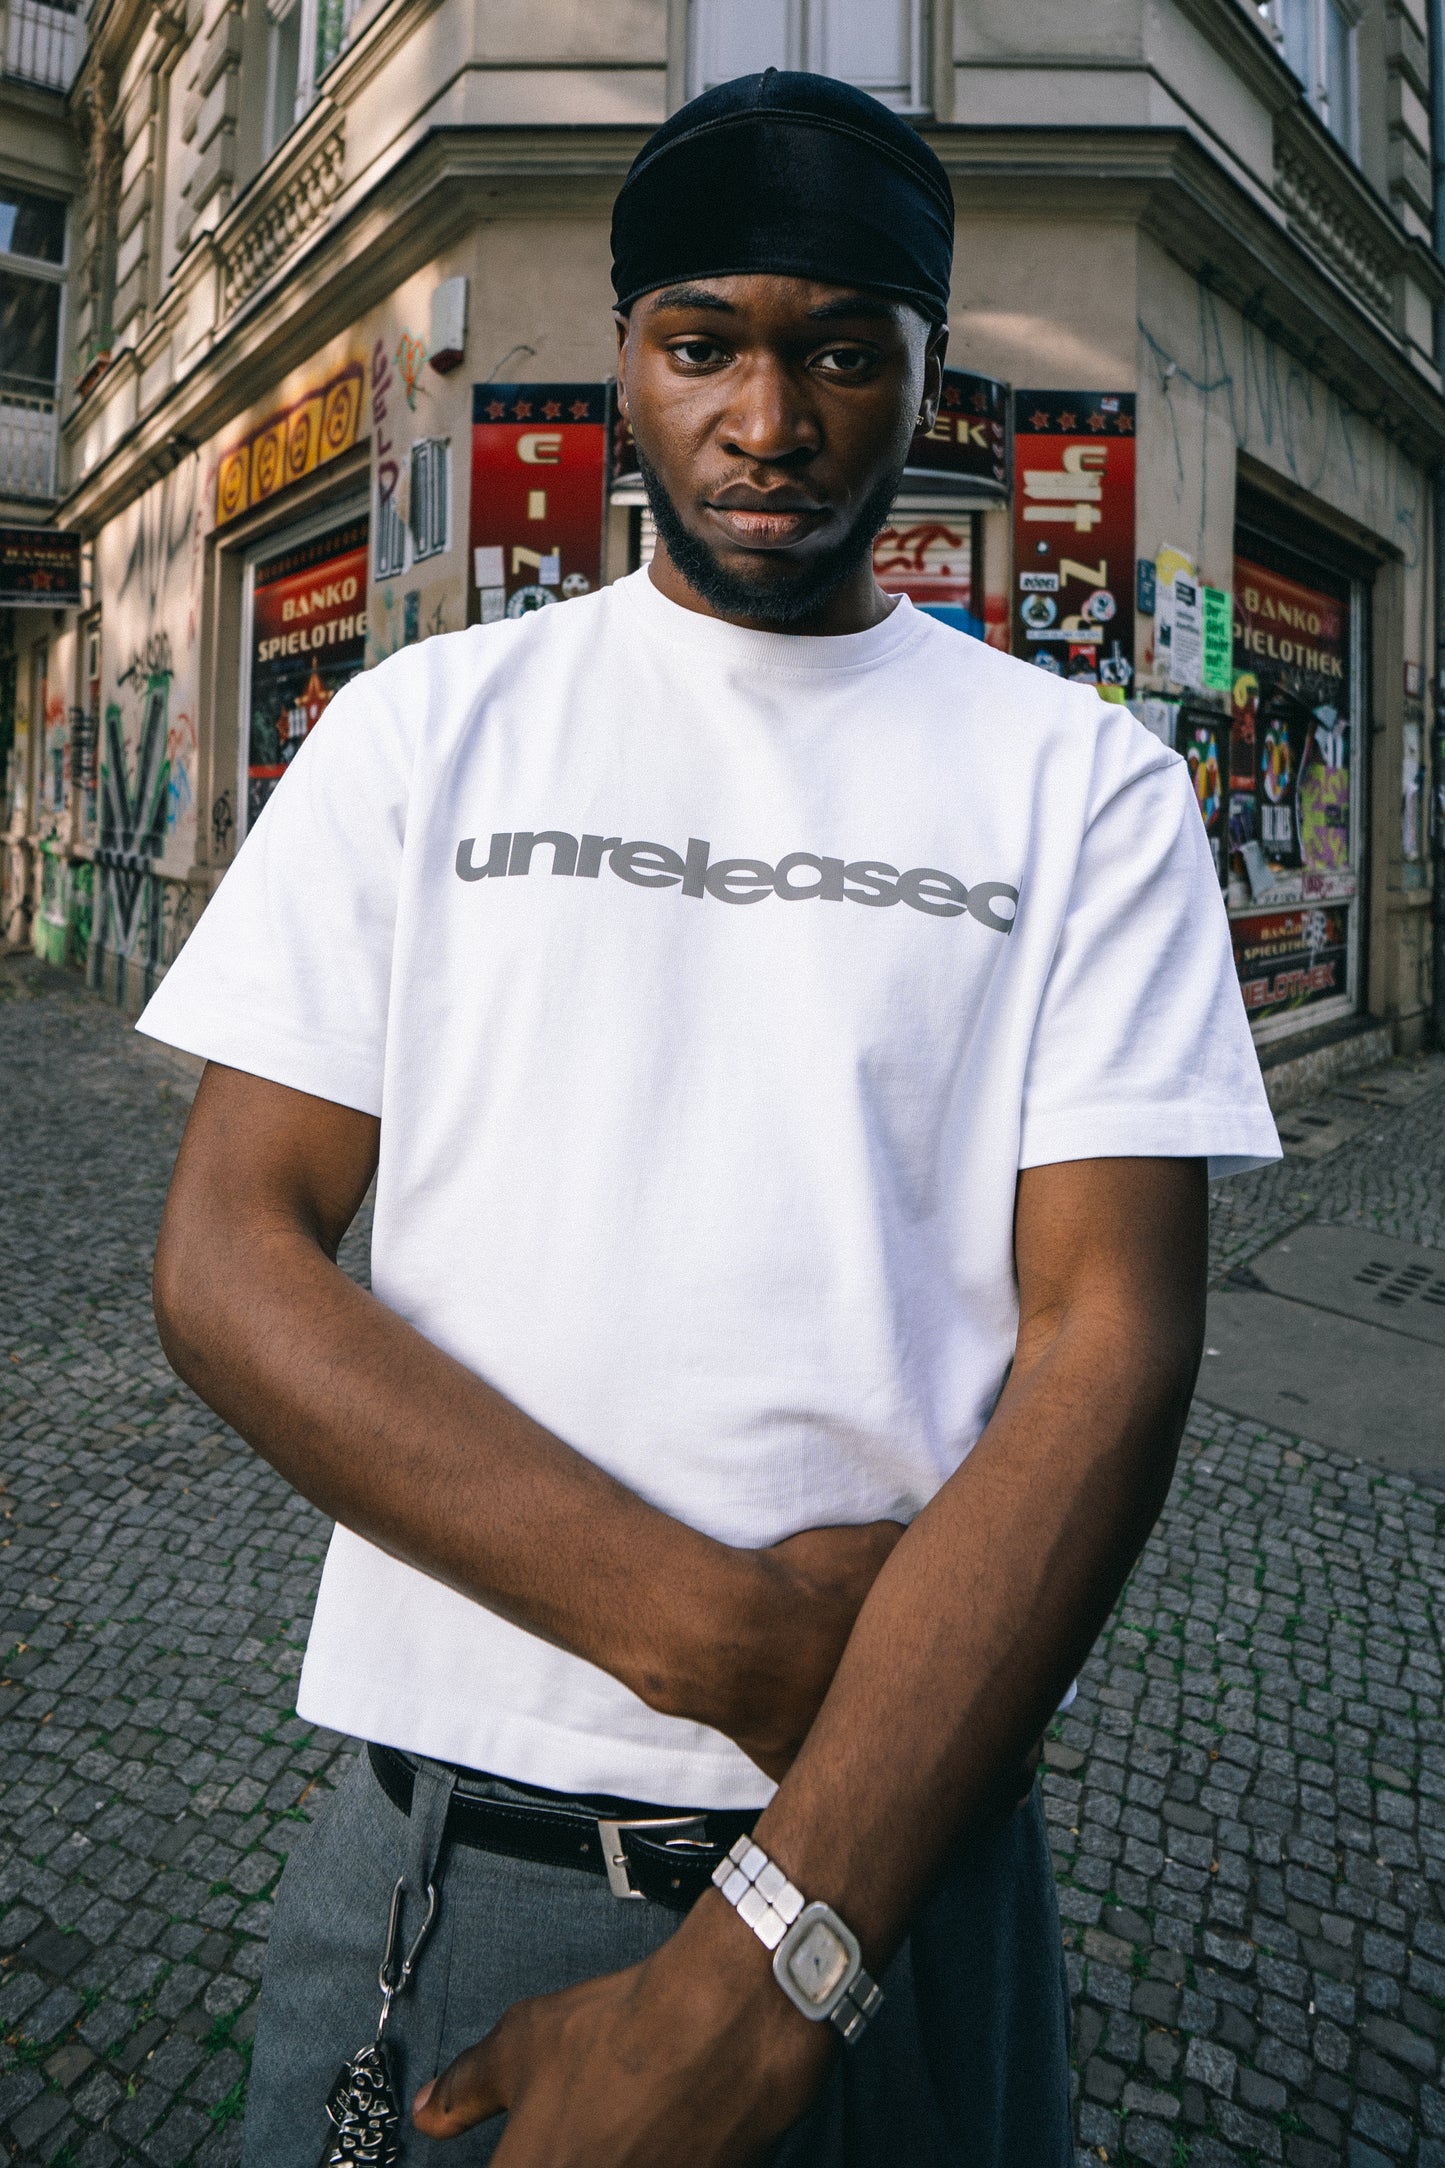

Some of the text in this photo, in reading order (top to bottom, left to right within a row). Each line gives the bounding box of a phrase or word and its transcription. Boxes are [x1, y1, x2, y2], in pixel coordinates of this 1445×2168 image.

[282, 576, 358, 622] BANKO
[1243, 587, 1321, 635] BANKO
[257, 610, 367, 662] SPIELOTHE
